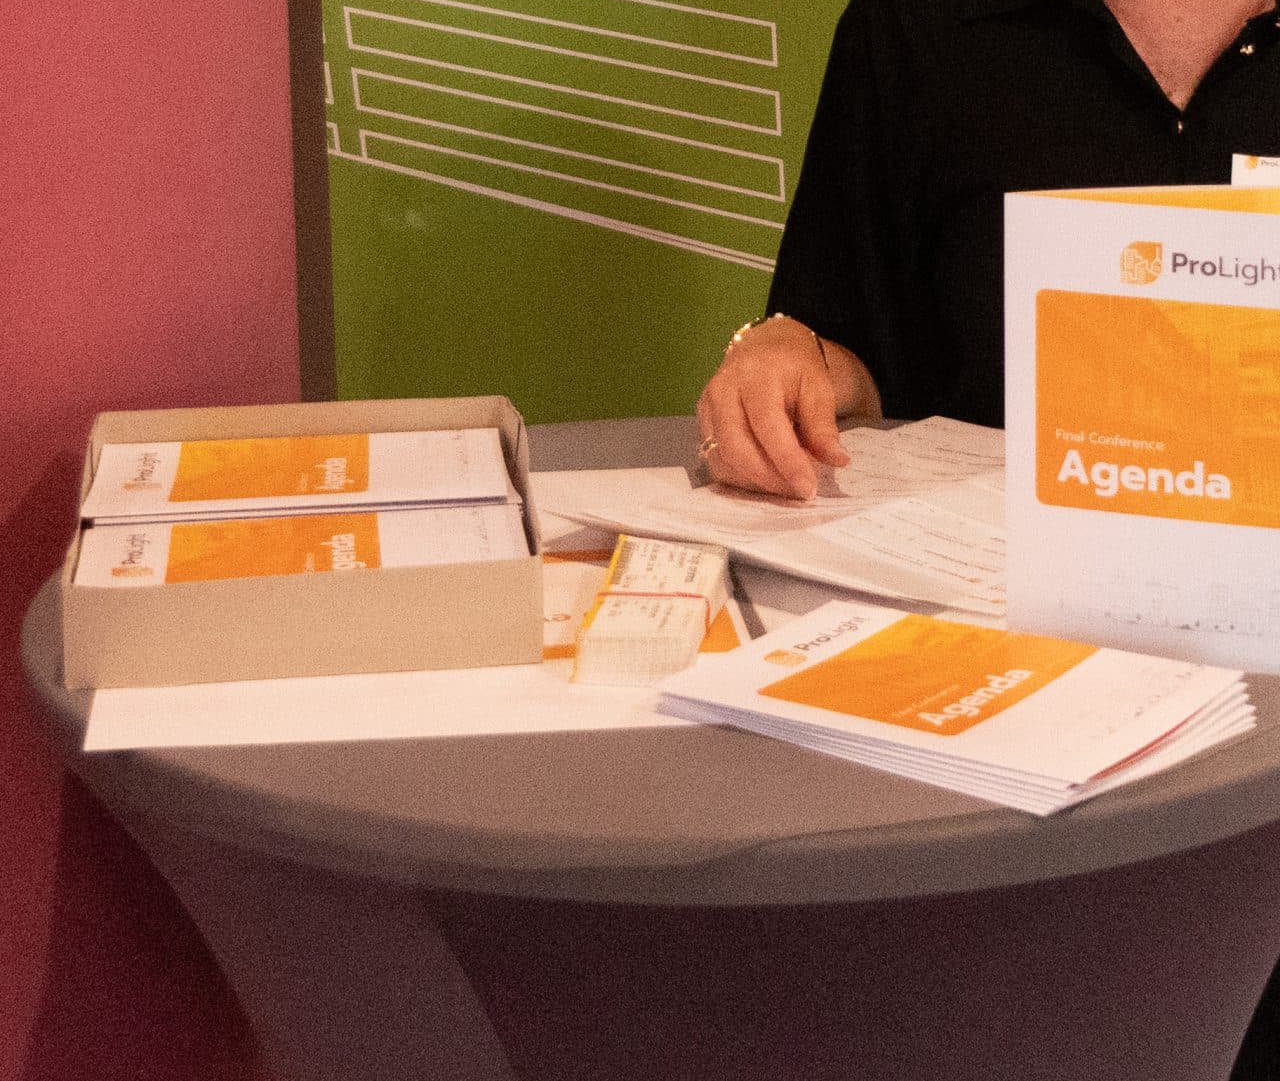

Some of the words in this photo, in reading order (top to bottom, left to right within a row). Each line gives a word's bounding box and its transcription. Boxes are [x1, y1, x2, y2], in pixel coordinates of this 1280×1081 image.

[1055, 428, 1084, 442] Final
[1089, 431, 1166, 451] Conference
[1057, 449, 1232, 499] Agenda
[320, 533, 368, 570] genda
[917, 669, 1033, 726] Agenda
